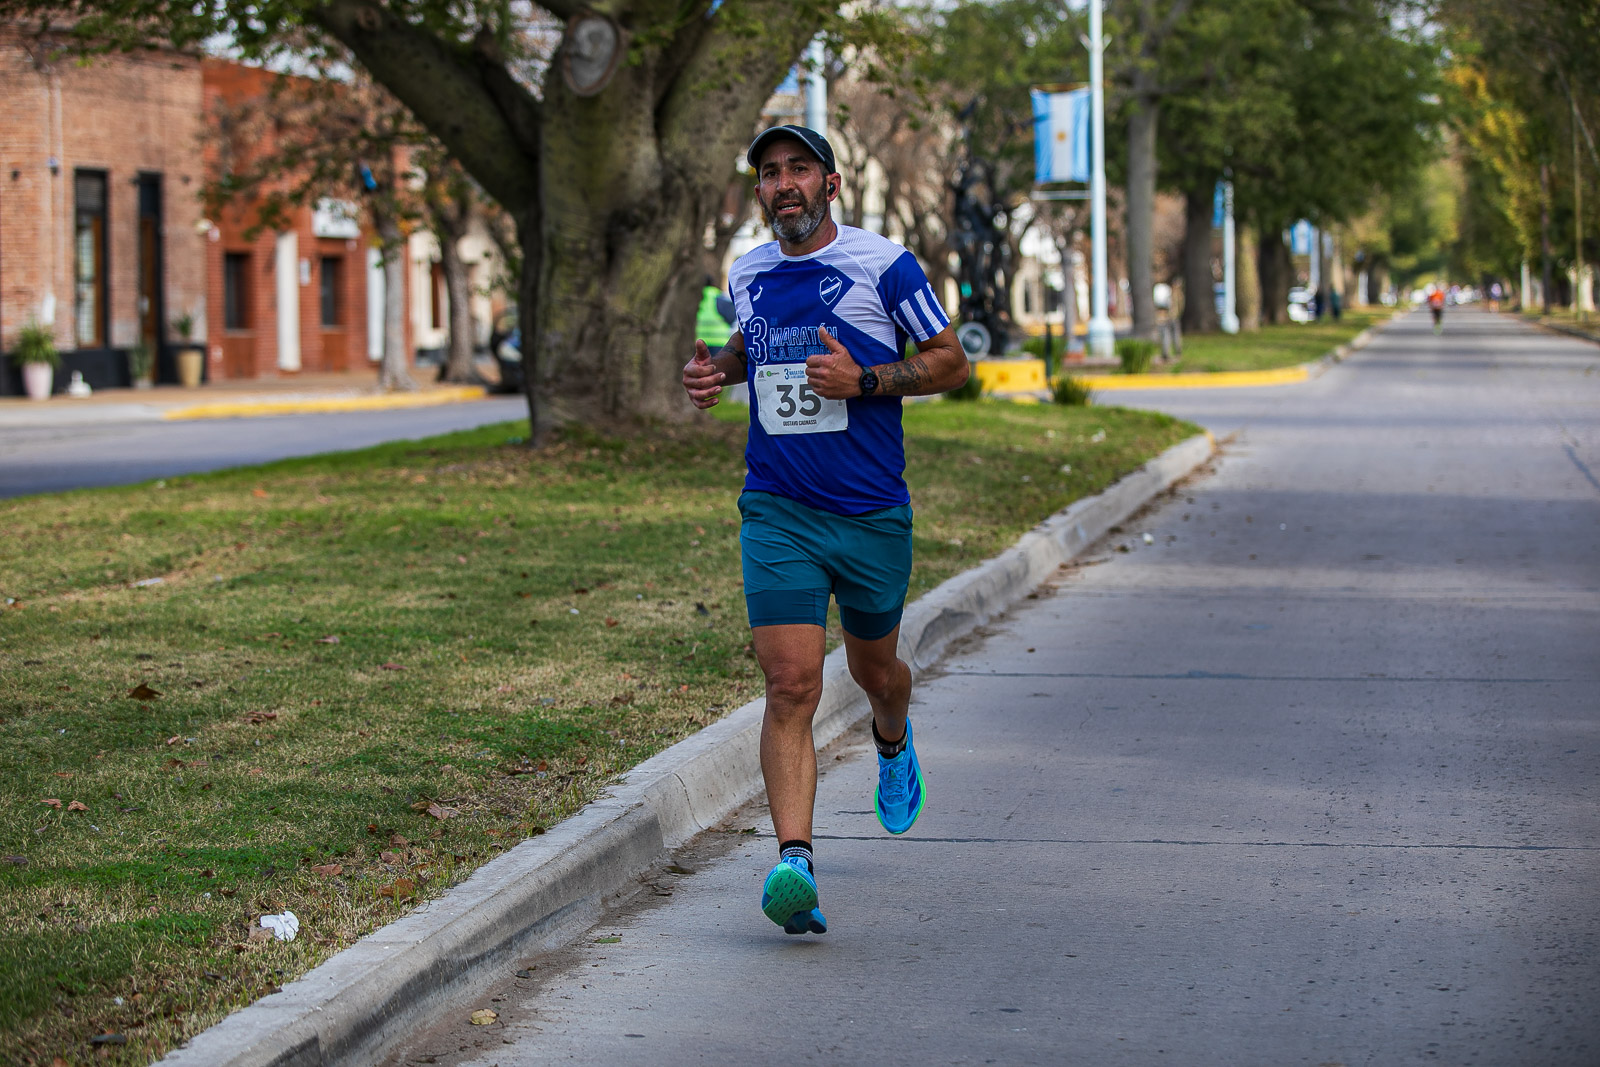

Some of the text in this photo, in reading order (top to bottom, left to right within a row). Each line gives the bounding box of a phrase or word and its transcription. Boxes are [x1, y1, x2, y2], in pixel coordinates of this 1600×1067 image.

[748, 316, 767, 364] 3
[784, 367, 790, 380] 3
[776, 384, 822, 418] 35
